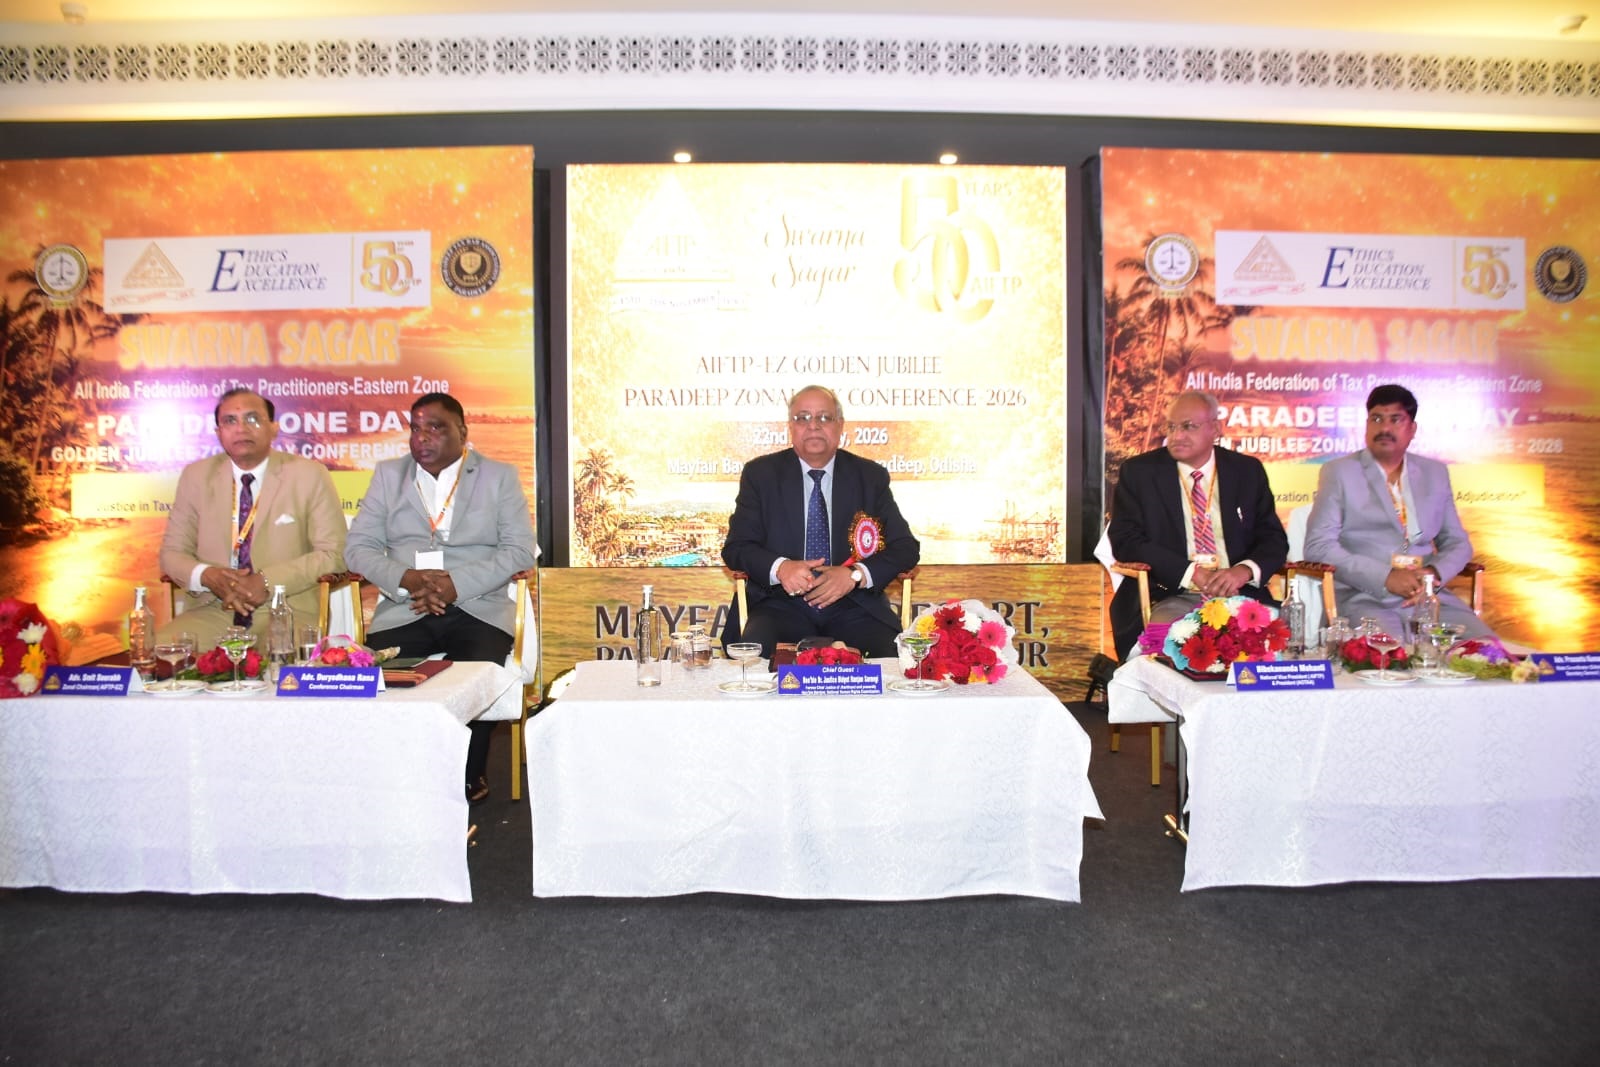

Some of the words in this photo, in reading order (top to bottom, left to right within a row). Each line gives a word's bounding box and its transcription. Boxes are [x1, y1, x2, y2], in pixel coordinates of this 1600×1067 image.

[120, 322, 269, 369] SWARNA
[280, 319, 399, 366] SAGAR
[1232, 317, 1377, 362] SWARNA
[1386, 318, 1498, 364] SAGAR
[793, 355, 870, 374] GOLDEN
[876, 355, 943, 377] JUBILEE
[74, 381, 93, 399] All
[96, 381, 130, 398] India
[133, 379, 208, 398] Federation
[212, 379, 227, 397] of
[258, 375, 409, 397] Practitioners-Eastern
[412, 375, 449, 394] Zone
[1186, 371, 1205, 390] All
[1208, 371, 1242, 390] India
[1246, 371, 1319, 391] Federation
[1323, 373, 1338, 391] of
[1340, 374, 1363, 391] Tax
[1508, 375, 1542, 393] Zone
[625, 388, 729, 407] PARADEEP
[734, 388, 794, 407] ZONA
[848, 388, 977, 407] CONFERENCE
[985, 388, 1028, 407] 2026
[279, 411, 347, 434] ONE
[752, 427, 788, 445] 22nd
[854, 427, 889, 445] 2026
[1236, 437, 1309, 454] JUBILEE
[1528, 438, 1563, 454] 2026
[51, 446, 121, 462] GOLDEN
[301, 442, 411, 460] CONFERENC
[929, 456, 977, 474] Odisha
